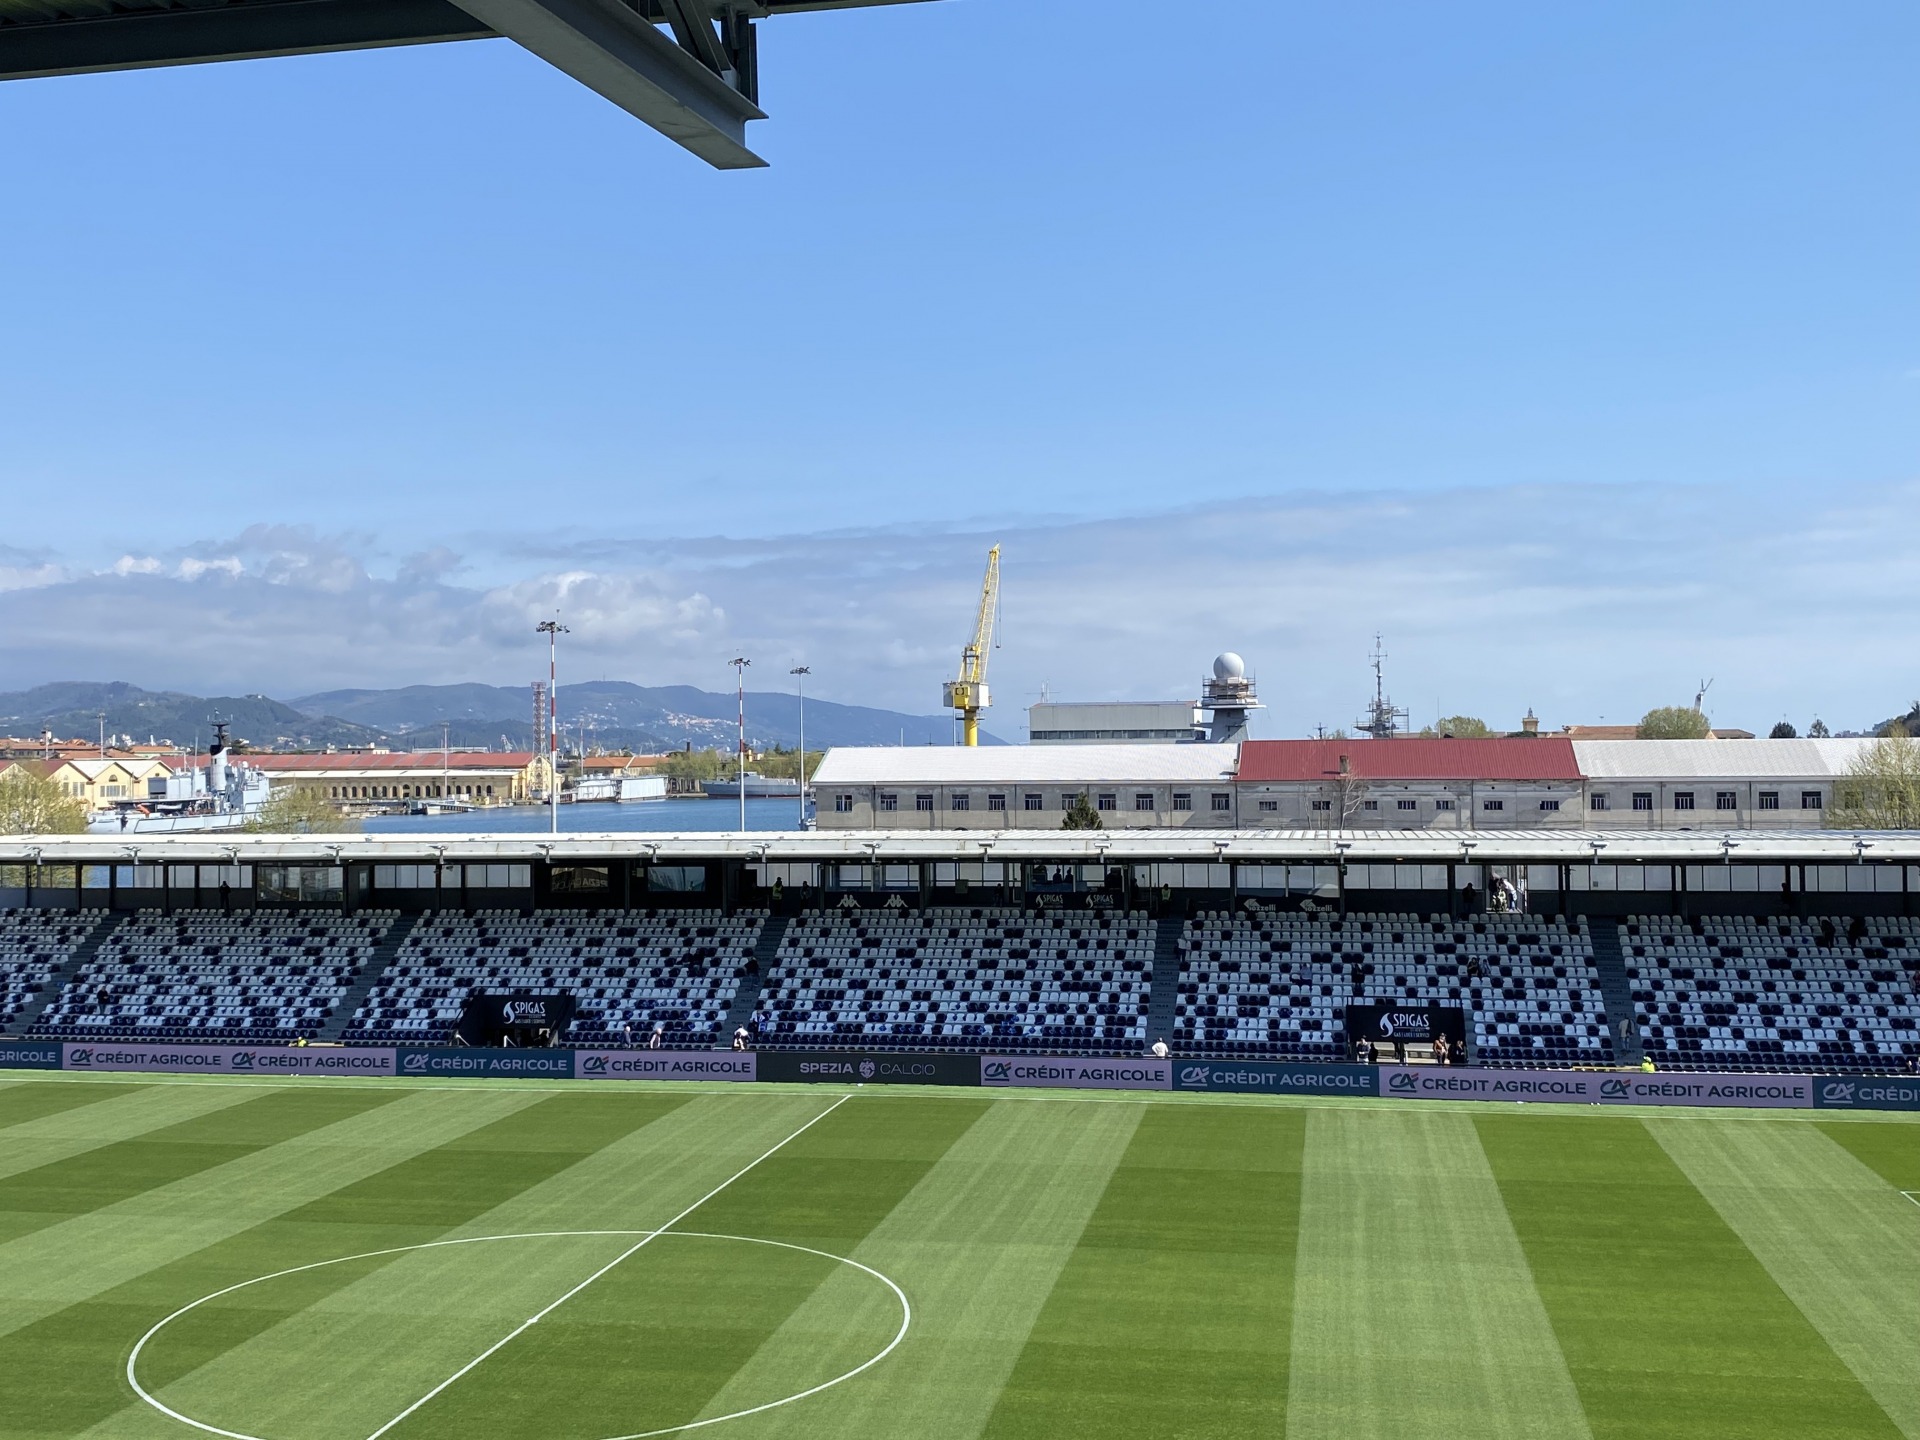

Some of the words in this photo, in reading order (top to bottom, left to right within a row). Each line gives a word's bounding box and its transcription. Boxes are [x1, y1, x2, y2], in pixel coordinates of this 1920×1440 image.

[1043, 894, 1064, 904] SPIGAS
[1093, 894, 1114, 904] SPIGAS
[514, 1001, 546, 1014] SPIGAS
[1393, 1013, 1430, 1027] SPIGAS
[96, 1051, 147, 1064] CRÉDIT
[149, 1054, 221, 1066] AGRICOLE
[258, 1054, 312, 1068] CRÉDIT
[315, 1057, 390, 1068] AGRICOLE
[431, 1056, 488, 1070] CRÉDIT
[489, 1059, 568, 1070] AGRICOLE
[611, 1058, 669, 1073] CRÉDIT
[671, 1061, 751, 1073] AGRICOLE
[799, 1062, 854, 1074] SPEZIA
[880, 1063, 936, 1076] CALCIO
[1014, 1065, 1075, 1080] CRÉDIT
[1079, 1068, 1164, 1082] AGRICOLE
[1212, 1070, 1276, 1085] CRÉDIT
[1280, 1073, 1370, 1088] AGRICOLE
[1422, 1076, 1489, 1092] CRÉDIT
[1493, 1080, 1587, 1095] AGRICOLE
[1635, 1082, 1704, 1097] CRÉDIT
[1708, 1085, 1805, 1099] AGRICOLE
[1859, 1086, 1920, 1102] CRÉDI
